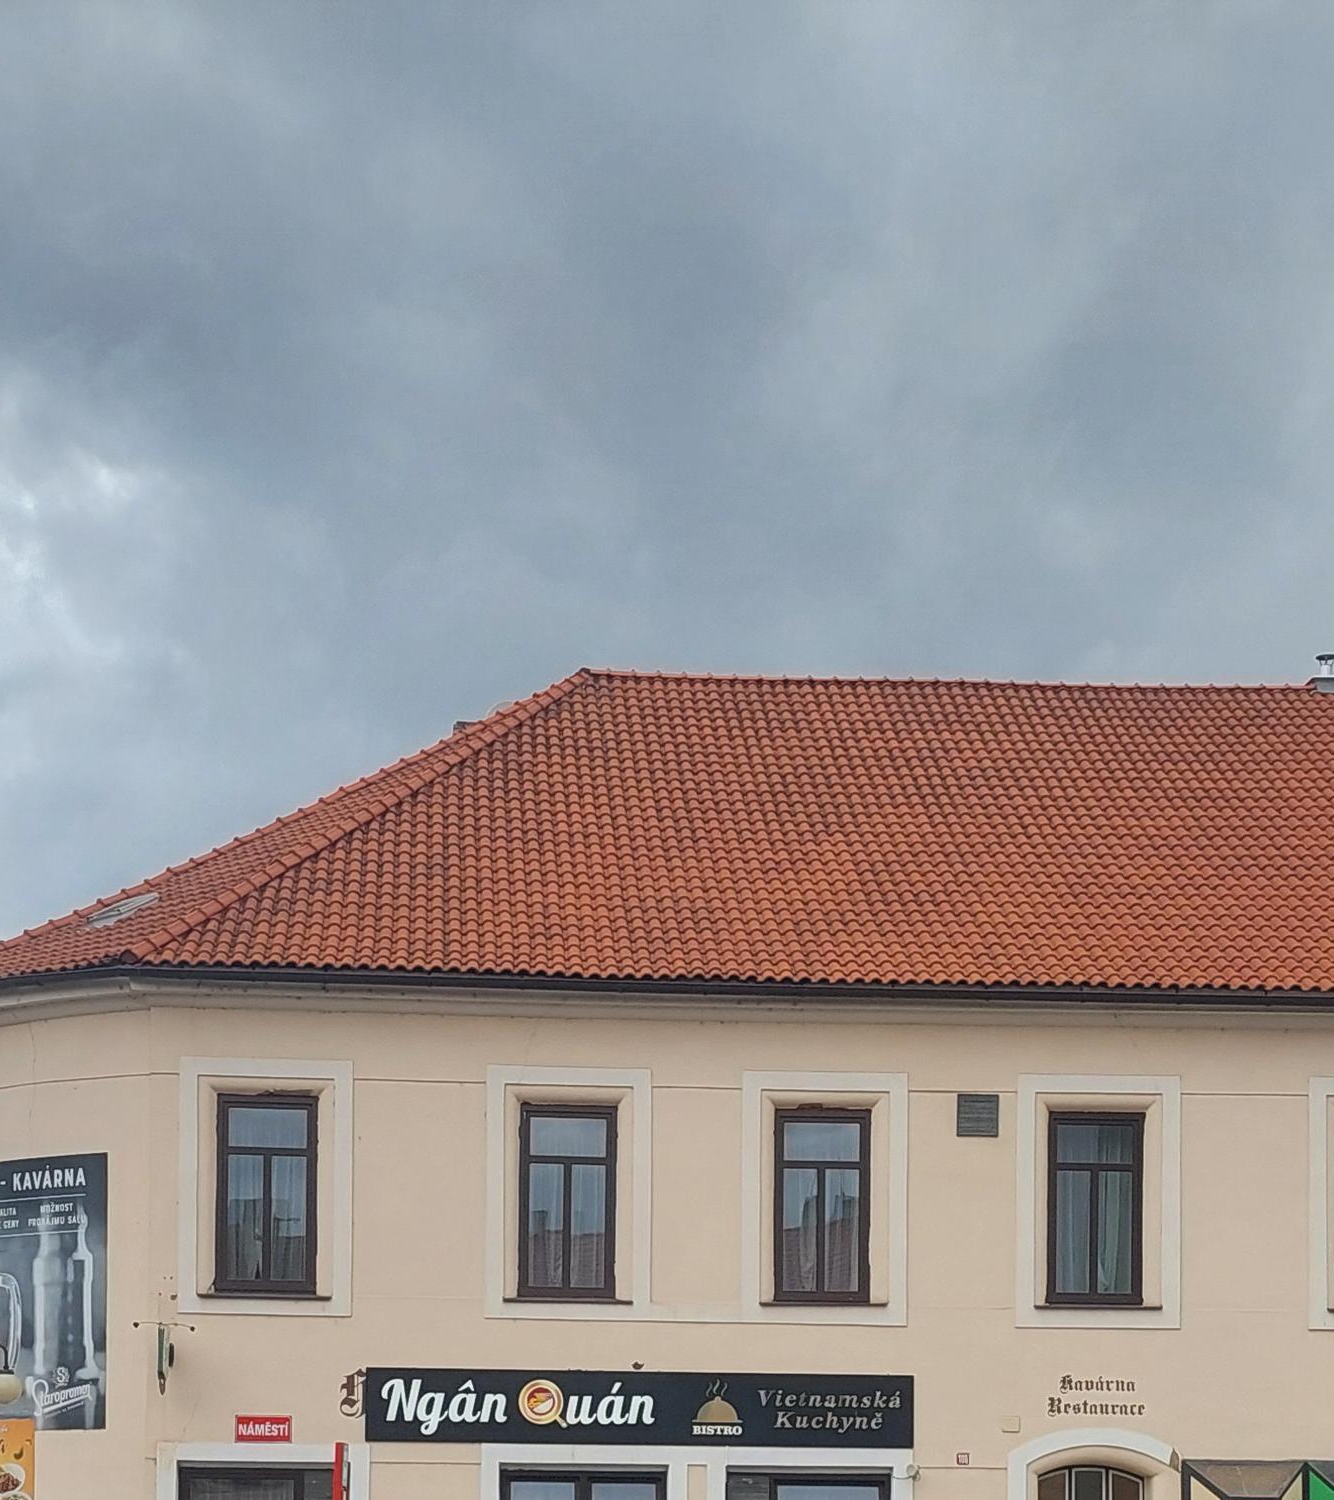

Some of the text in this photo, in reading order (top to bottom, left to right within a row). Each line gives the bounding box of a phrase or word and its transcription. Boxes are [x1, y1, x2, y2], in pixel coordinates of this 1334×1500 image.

[12, 1165, 86, 1192] KAVÁRNA
[1059, 1374, 1136, 1394] Kavárna
[381, 1378, 508, 1436] Ngân
[757, 1389, 902, 1409] Vietnamská
[1047, 1396, 1146, 1417] Restaurace
[238, 1420, 289, 1437] NÁMĚSTÍ
[691, 1424, 743, 1437] BISTRO
[773, 1411, 884, 1434] Kuchyně
